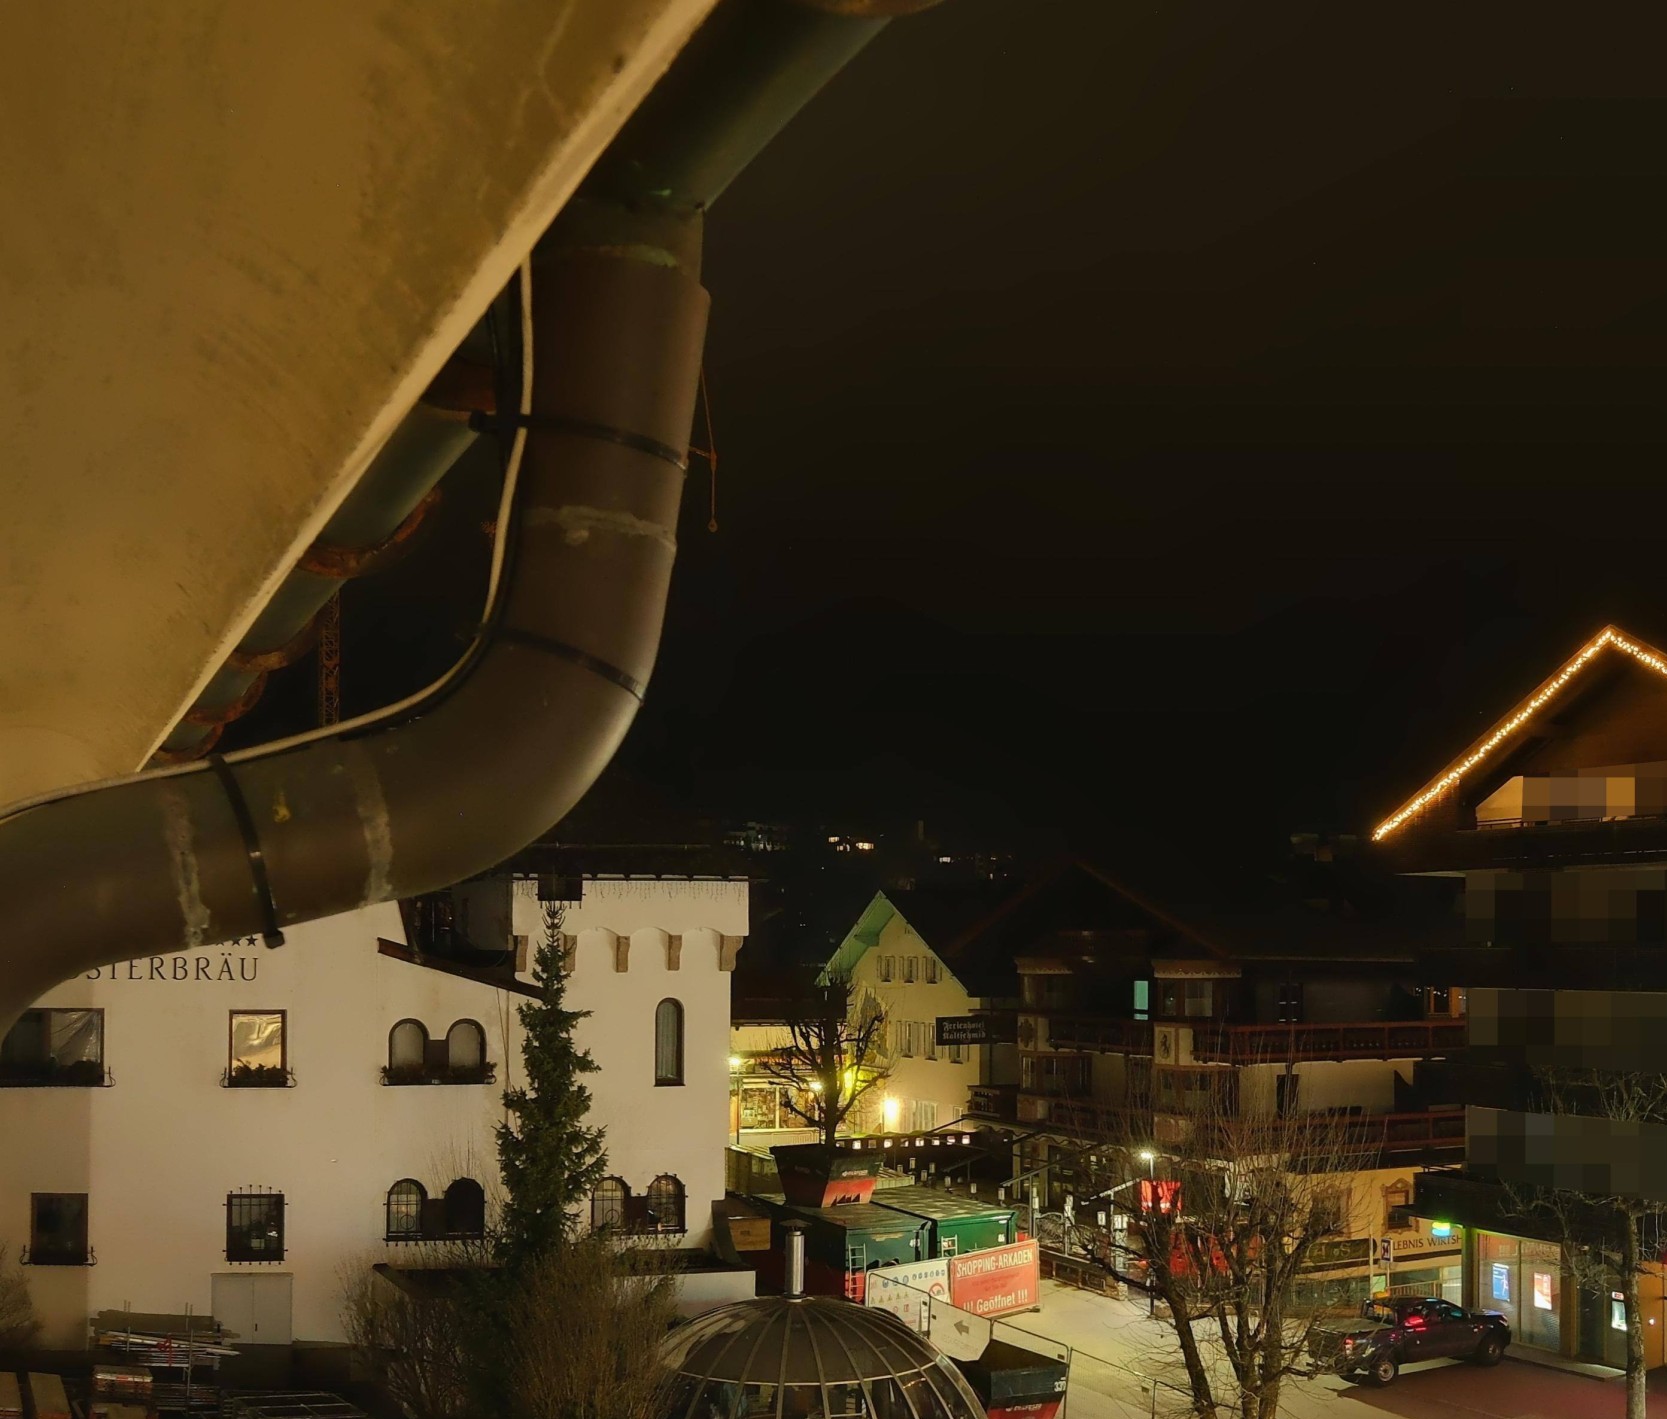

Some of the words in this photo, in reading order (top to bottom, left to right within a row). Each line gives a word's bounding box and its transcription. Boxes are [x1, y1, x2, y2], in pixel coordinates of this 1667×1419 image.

[66, 953, 259, 981] STERBRÄU
[956, 1248, 1033, 1277] SHOPPING-ARKADEN
[976, 1292, 1015, 1313] Geöffnet
